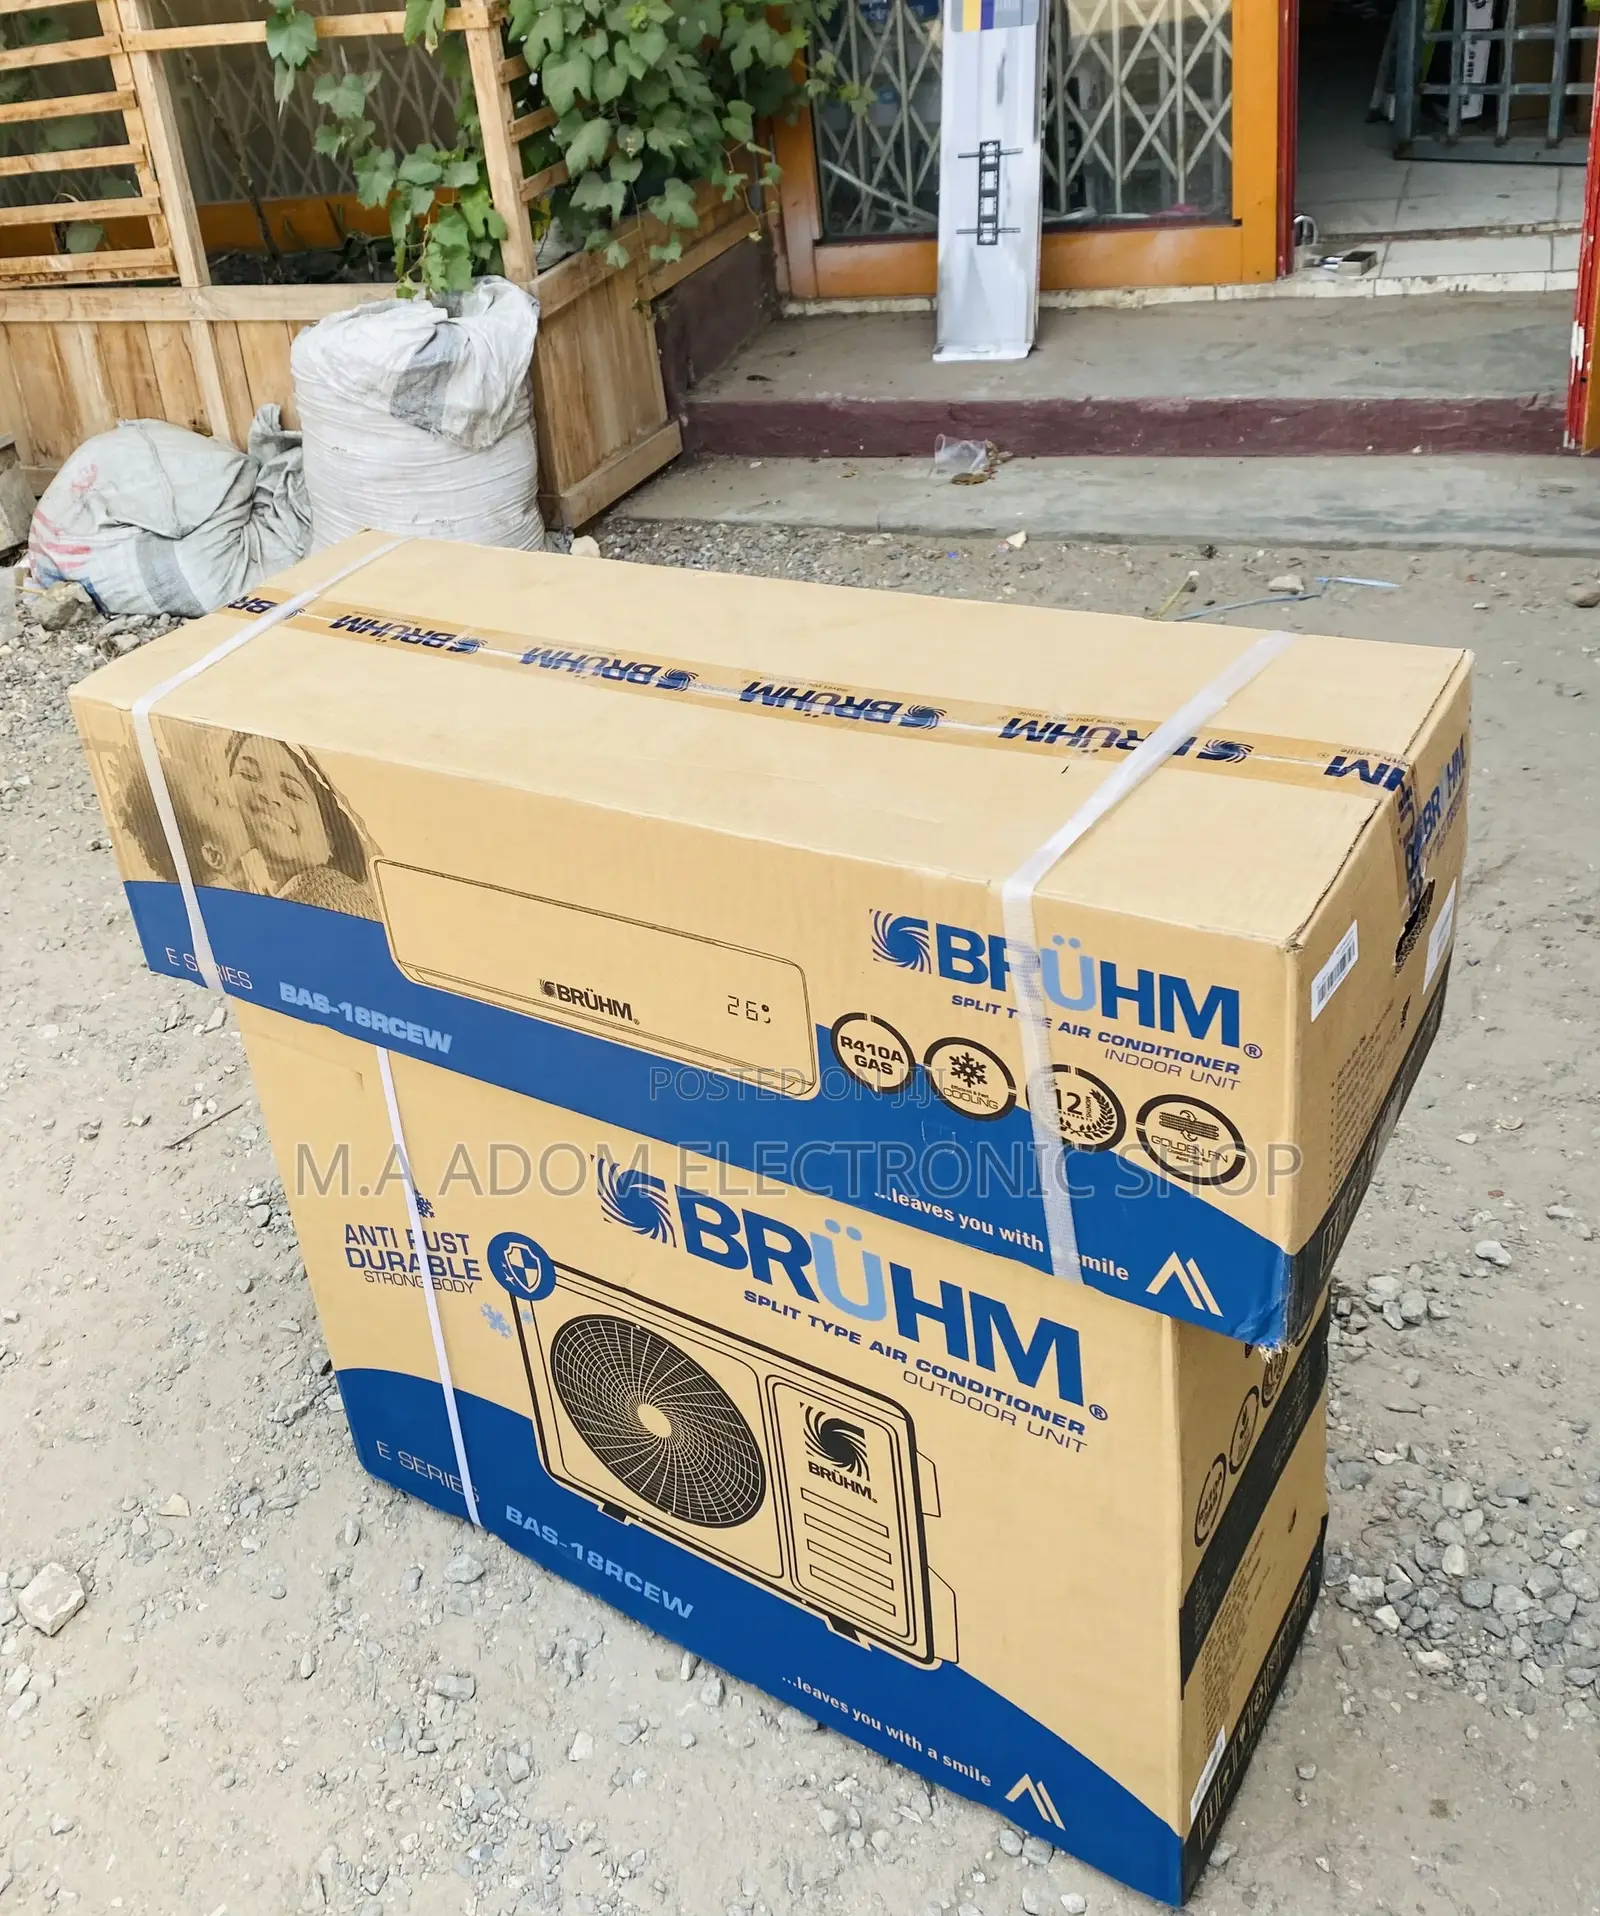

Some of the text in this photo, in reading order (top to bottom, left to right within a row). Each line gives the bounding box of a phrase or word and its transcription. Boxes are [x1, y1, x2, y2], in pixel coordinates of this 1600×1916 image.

[329, 614, 457, 650] BRÜHM
[519, 647, 662, 685] BRÜHM
[739, 681, 903, 723] BRÜHM
[165, 947, 253, 990] E SIES
[279, 980, 452, 1054] BAS-18RCEW
[556, 983, 633, 1021] BRÜHM
[840, 1035, 904, 1065] R410A
[951, 994, 1240, 1075] SPLIT TE AIR CONDITIONER
[854, 1054, 893, 1076] GAS
[1105, 1048, 1241, 1091] INDOOR UNIT
[943, 1087, 999, 1110] COOLING
[1151, 1135, 1205, 1157] GOLDEN
[345, 1223, 398, 1249] ANTI
[959, 1212, 993, 1236] you
[999, 1226, 1044, 1252] with
[345, 1247, 483, 1281] DURABLE
[363, 1270, 475, 1294] STRONG BODY
[675, 1184, 1085, 1408] BRÜHM
[743, 1289, 1086, 1437] SPLIT TYPE AIR CONDITIONER
[903, 1370, 1088, 1454] OUTDOOR UNIT
[376, 1440, 391, 1461] E
[808, 1460, 872, 1500] BRÜHM
[505, 1504, 695, 1620] BAS-18RCEW
[852, 1707, 882, 1731] you
[885, 1724, 923, 1752] with
[928, 1747, 938, 1761] a
[943, 1755, 992, 1787] smile
